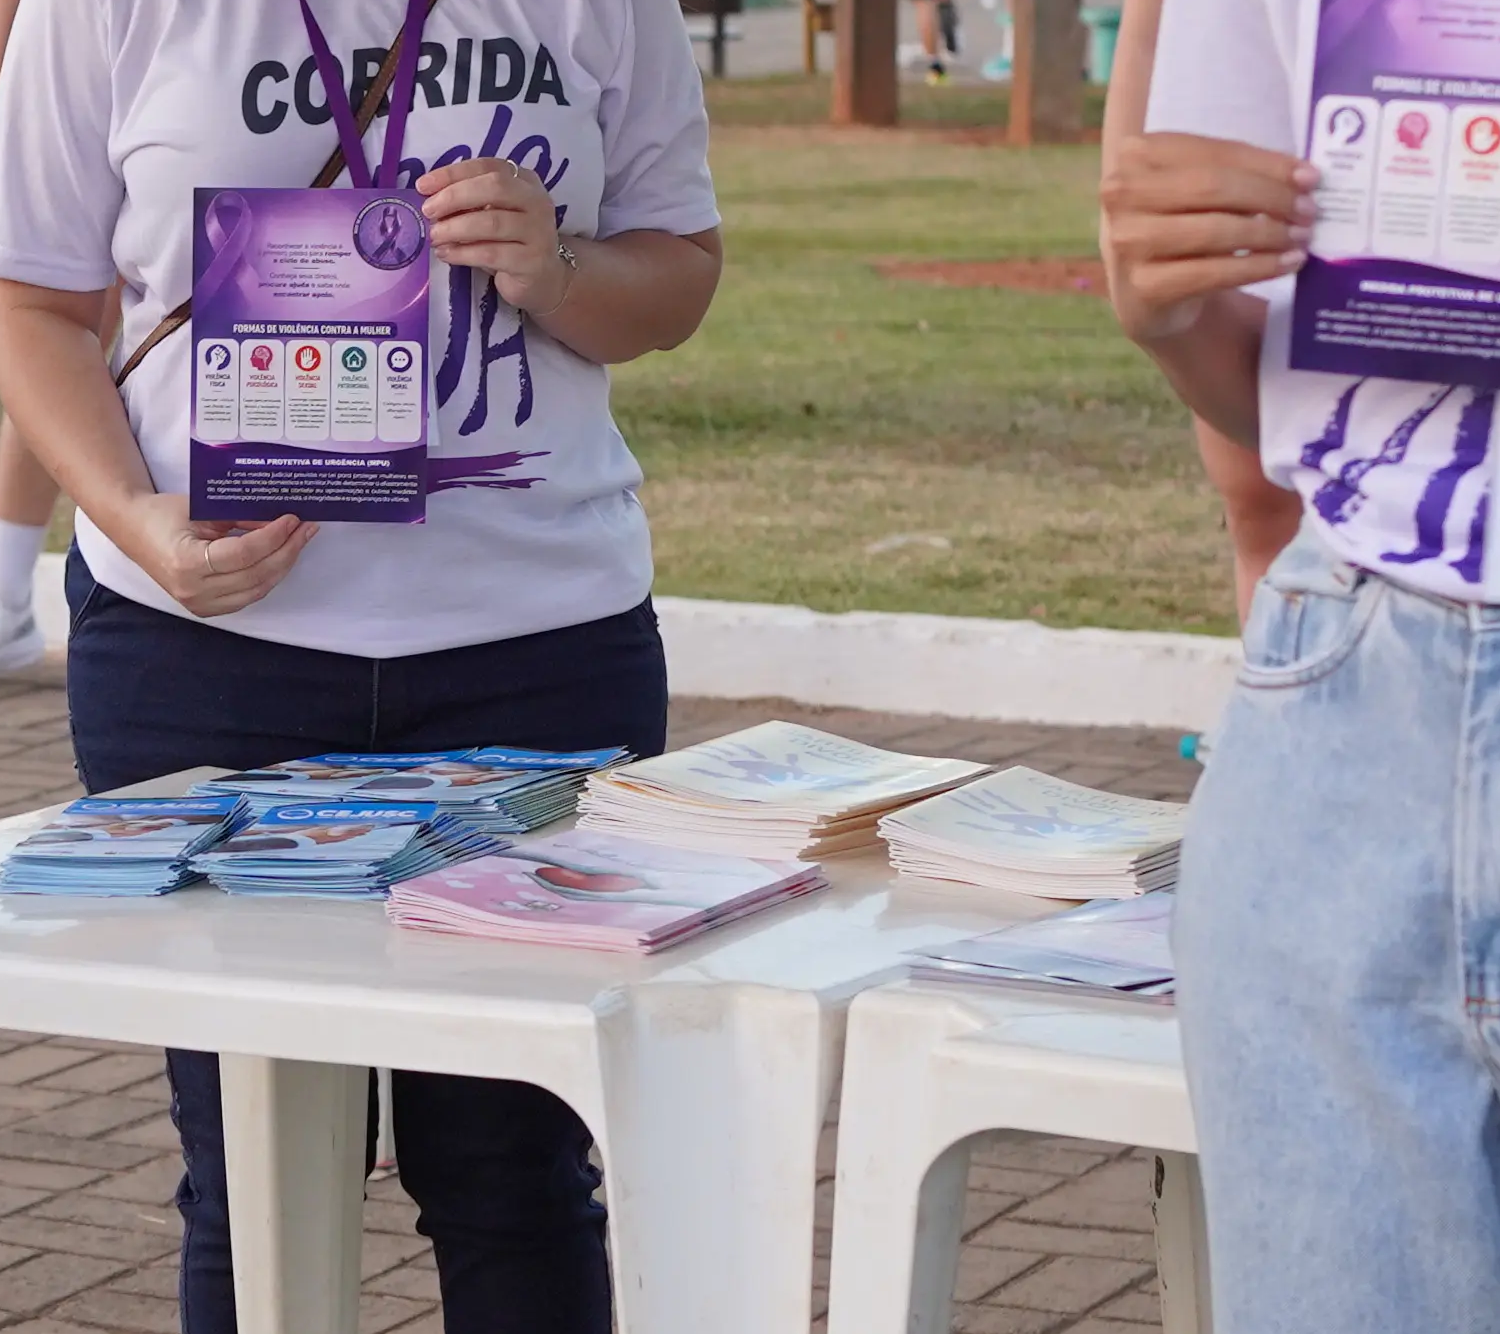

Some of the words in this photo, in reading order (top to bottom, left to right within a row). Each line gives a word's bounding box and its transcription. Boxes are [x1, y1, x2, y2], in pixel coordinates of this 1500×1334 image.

[233, 323, 265, 334] FORMAS
[267, 324, 278, 334] DE
[279, 322, 319, 335] VIOLÊNCIA
[320, 325, 351, 335] CONTRA
[352, 325, 359, 335] A
[360, 325, 391, 335] MULHER
